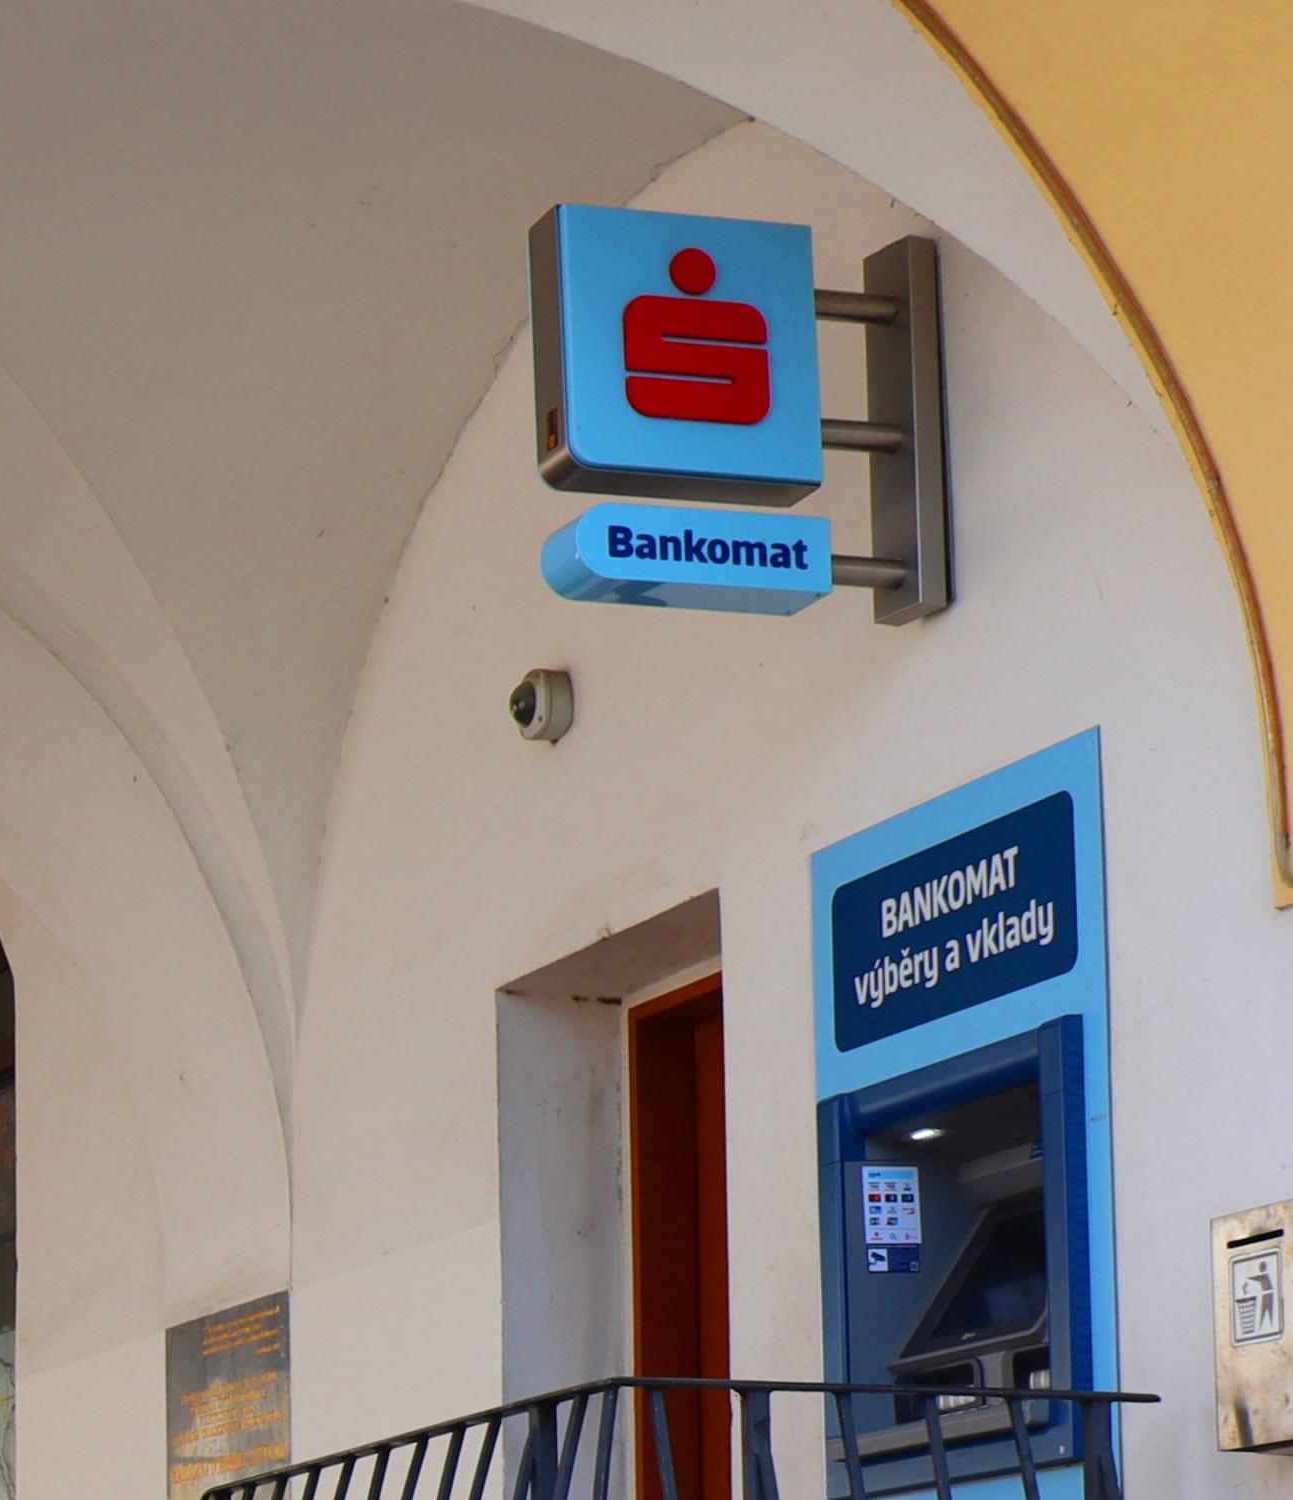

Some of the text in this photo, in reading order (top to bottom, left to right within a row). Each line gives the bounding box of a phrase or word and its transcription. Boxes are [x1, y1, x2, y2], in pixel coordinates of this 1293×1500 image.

[607, 525, 809, 570] Bankomat
[880, 846, 1019, 939] BANKOMAT
[854, 898, 1055, 1009] výběry a vklady
